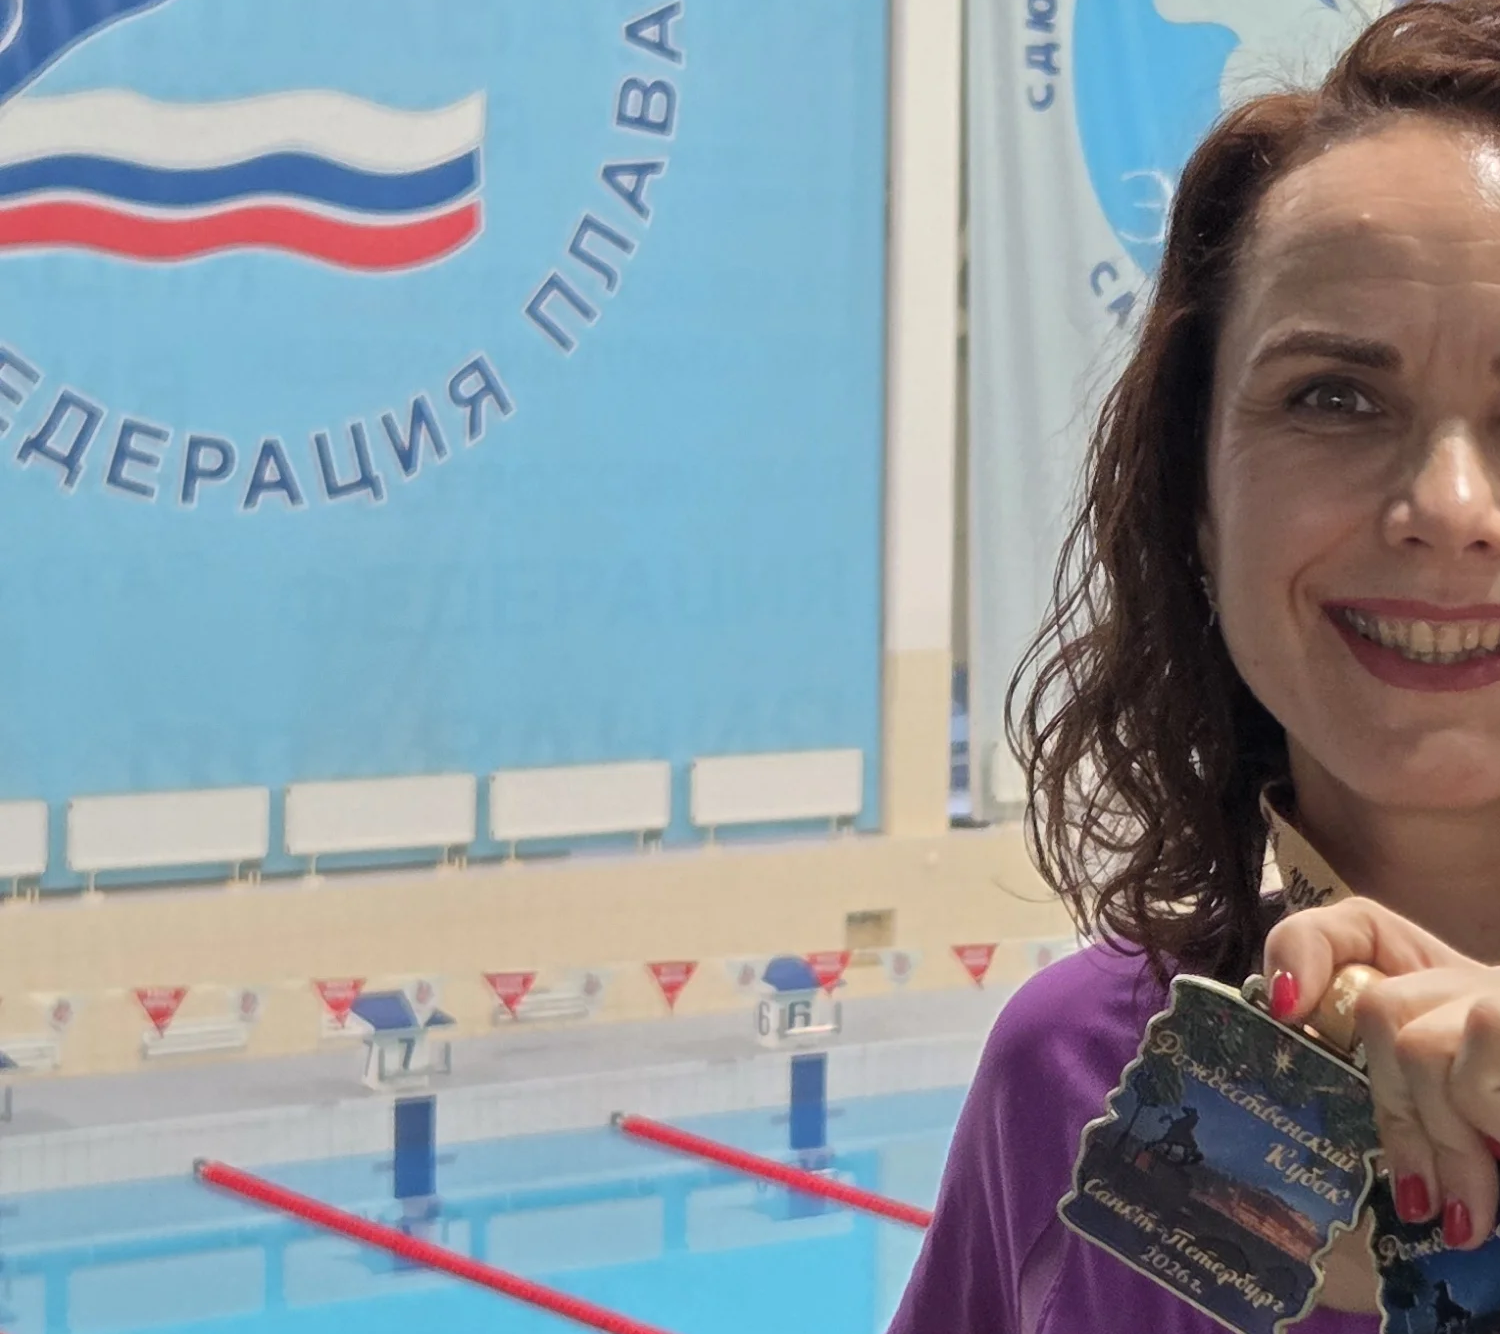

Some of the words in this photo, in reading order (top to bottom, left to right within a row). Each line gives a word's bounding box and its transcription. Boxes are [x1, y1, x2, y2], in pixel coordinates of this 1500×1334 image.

[758, 1000, 771, 1036] 6
[788, 1000, 812, 1030] 6
[398, 1036, 416, 1071] 7
[1151, 1030, 1360, 1173] Рождественский
[1264, 1142, 1351, 1207] Кубок
[1084, 1178, 1286, 1315] Санкт-Петербург
